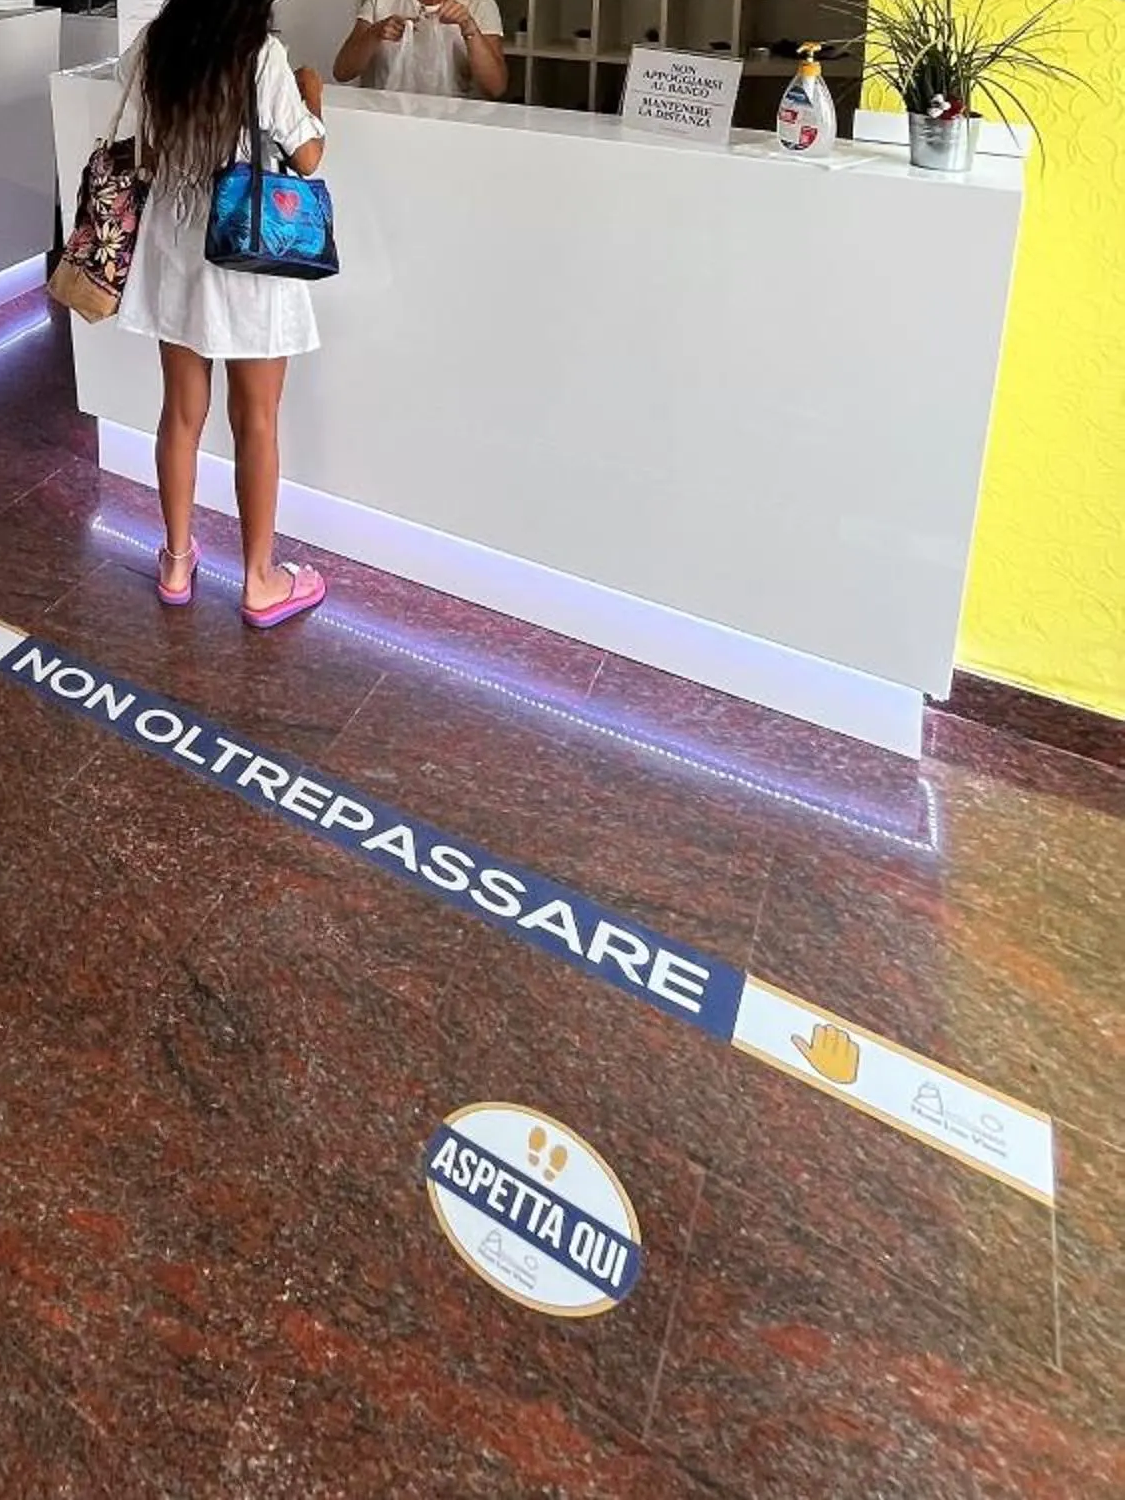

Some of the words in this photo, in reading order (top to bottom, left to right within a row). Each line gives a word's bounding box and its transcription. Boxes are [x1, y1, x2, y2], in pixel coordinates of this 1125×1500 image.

[643, 69, 724, 90] APPOGGIARSI
[672, 63, 696, 75] NON
[651, 81, 665, 91] AL
[668, 85, 709, 99] BANCO
[638, 106, 652, 117] LA
[656, 109, 711, 128] DISTANZA
[642, 97, 712, 117] MANTENERE
[11, 647, 136, 721] NON
[134, 707, 710, 1013] OLTREPASSARE
[430, 1136, 565, 1249] ASPETTA
[568, 1220, 628, 1288] QUI
